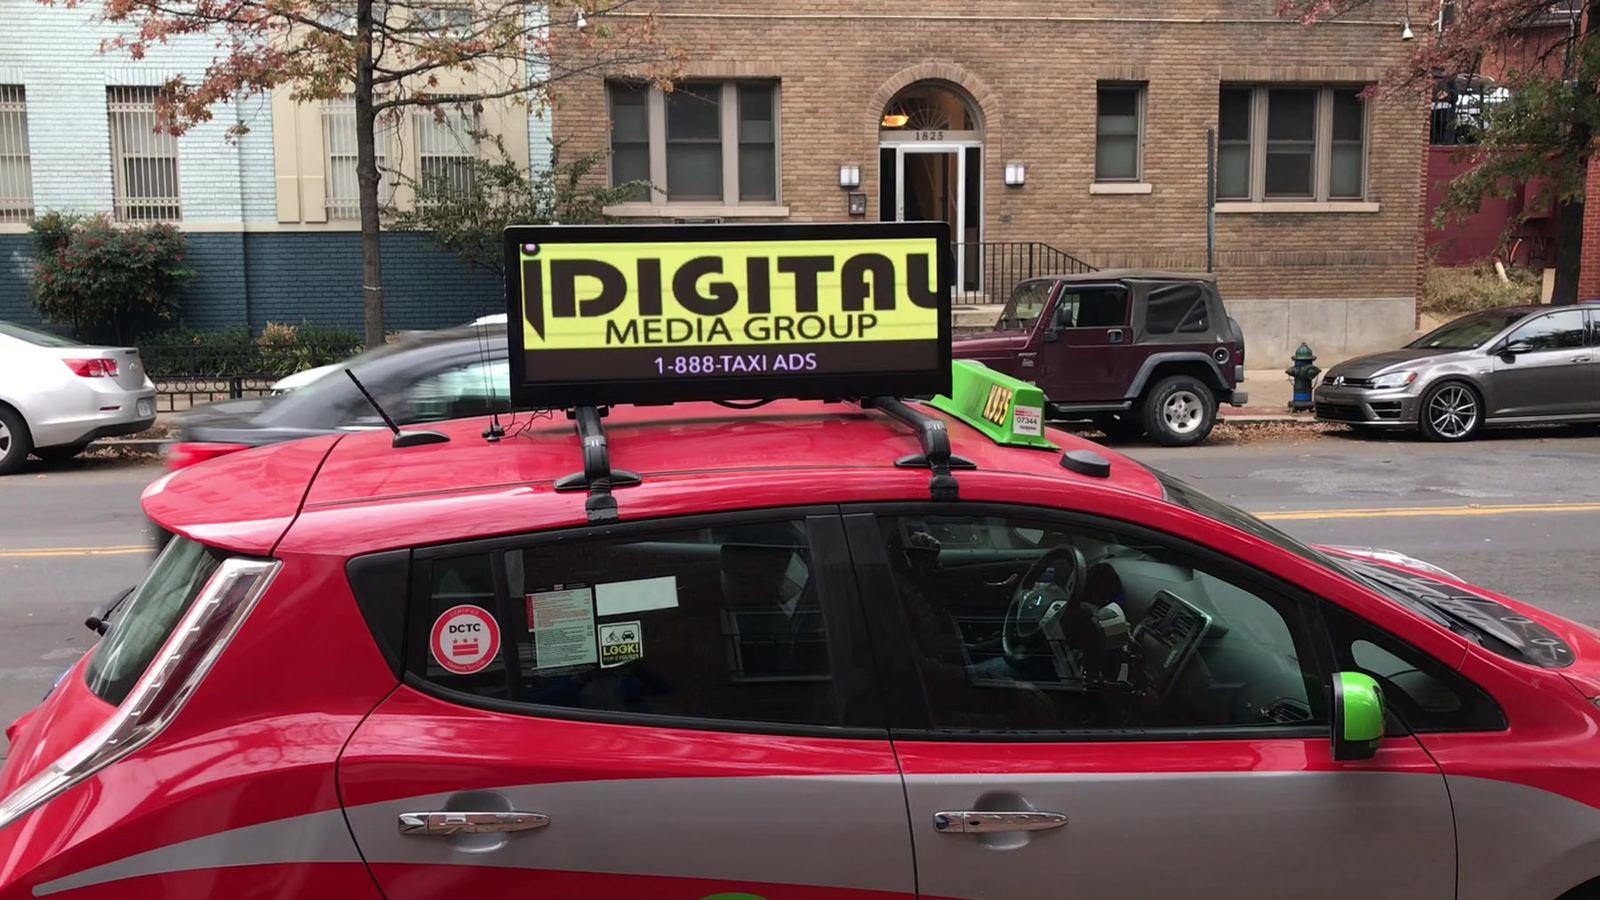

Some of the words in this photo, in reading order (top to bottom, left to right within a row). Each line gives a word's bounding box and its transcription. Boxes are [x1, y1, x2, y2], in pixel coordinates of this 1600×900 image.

[915, 131, 944, 141] 1825
[605, 316, 733, 345] MEDIA
[743, 314, 879, 342] GROUP
[653, 354, 767, 375] 1-888-TAXI
[774, 352, 817, 371] ADS
[449, 623, 481, 634] DCTC
[603, 643, 639, 656] LOOK!
